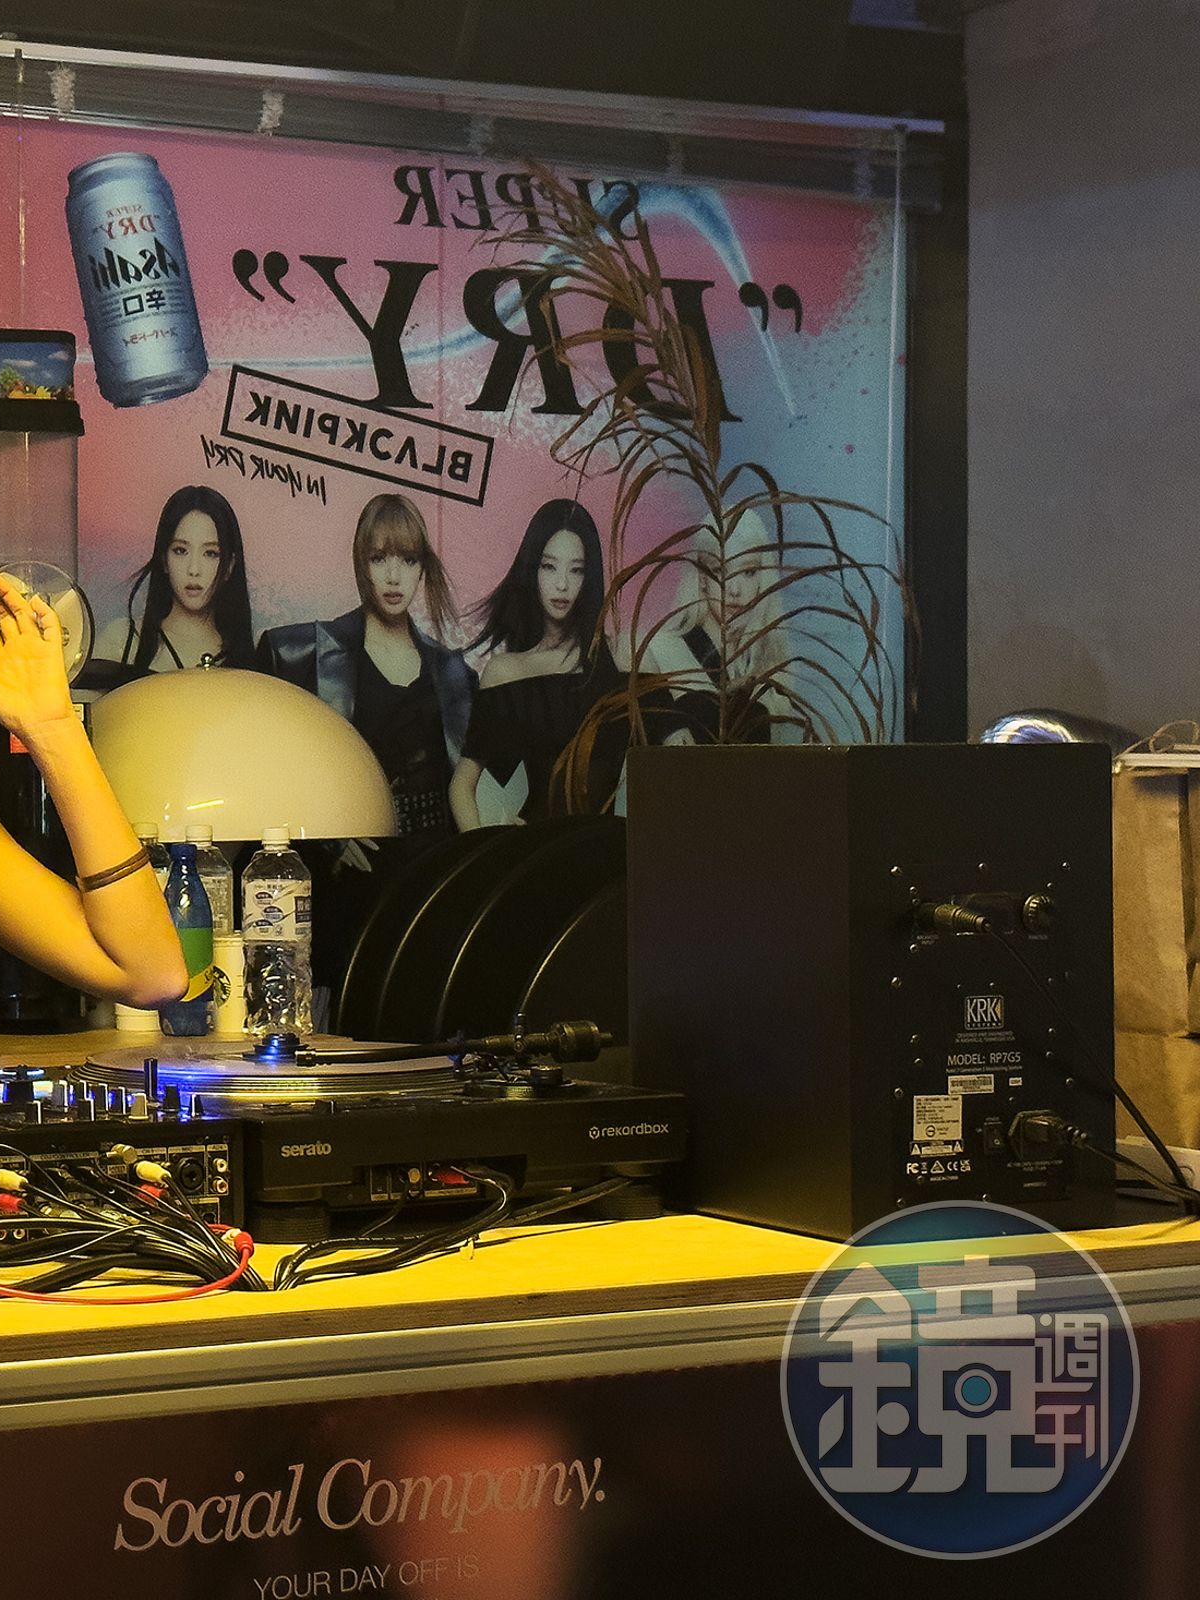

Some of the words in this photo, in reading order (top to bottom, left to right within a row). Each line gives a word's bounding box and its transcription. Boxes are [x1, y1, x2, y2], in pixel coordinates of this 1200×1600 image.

[967, 999, 1000, 1023] KRK
[989, 1052, 1022, 1064] RP7G5
[601, 1121, 670, 1138] rekordbox
[280, 1140, 332, 1158] serato
[113, 1462, 305, 1551] Social
[316, 1456, 606, 1535] Company.
[253, 1570, 332, 1600] YOUR
[340, 1564, 391, 1593] DAY
[398, 1557, 448, 1586] OFF
[456, 1553, 480, 1579] IS
